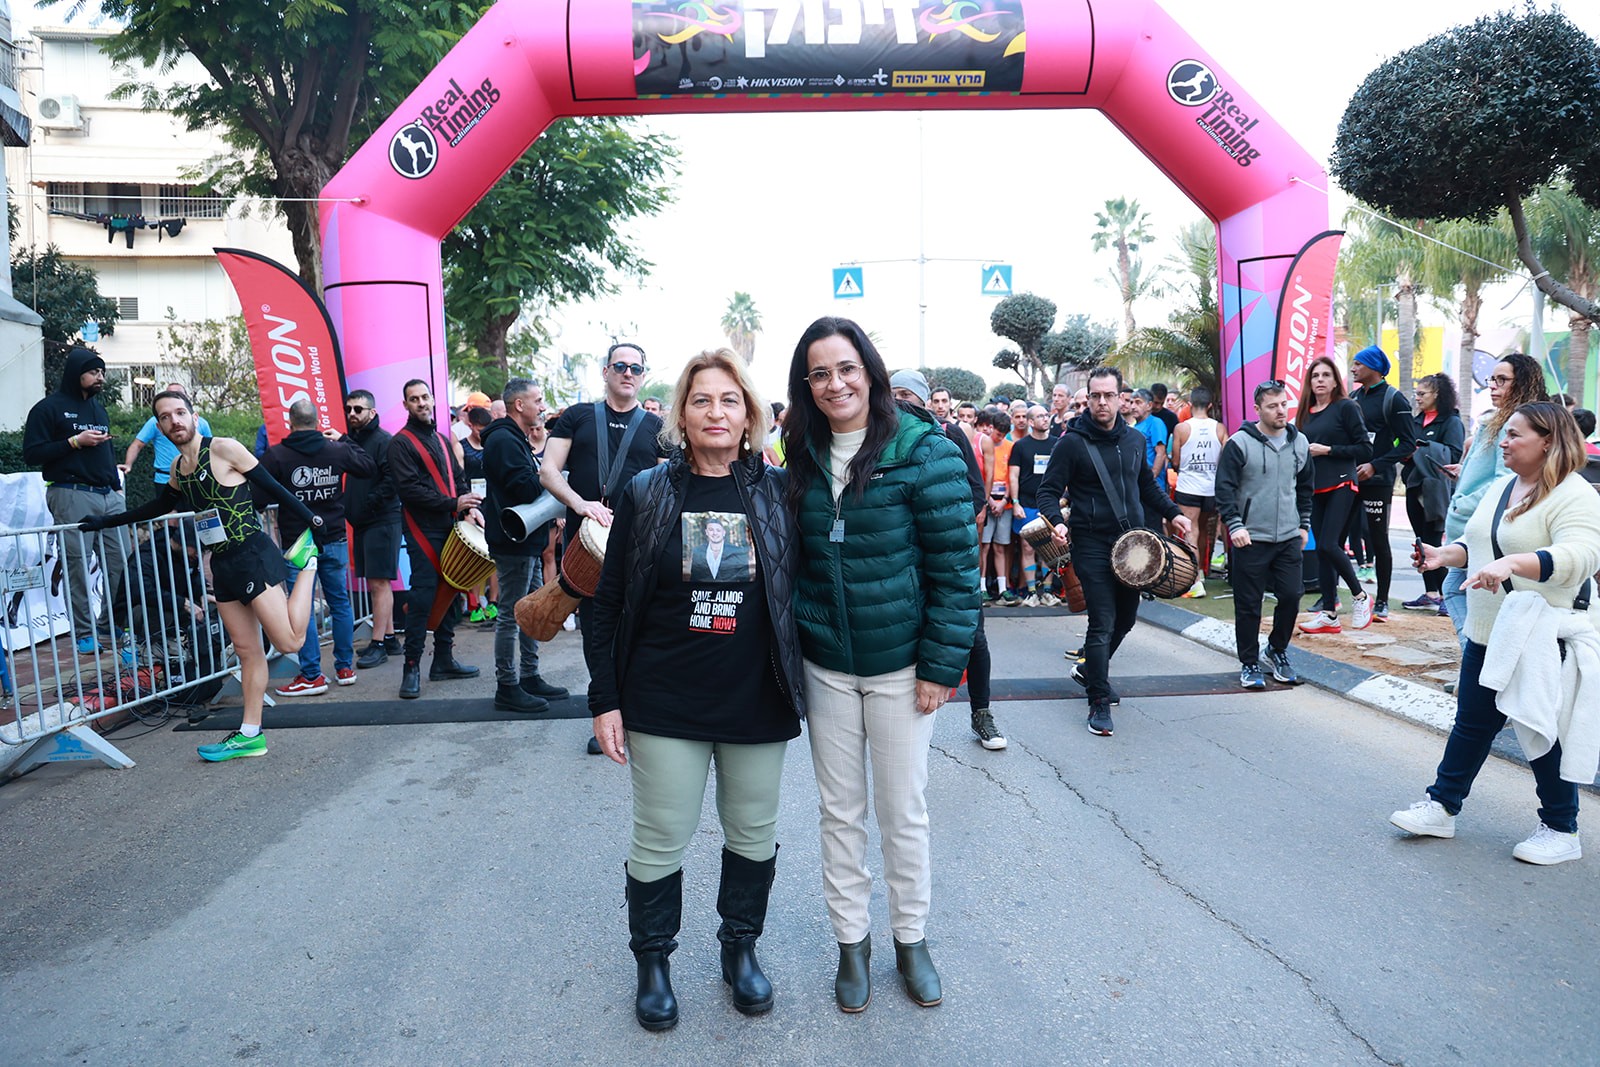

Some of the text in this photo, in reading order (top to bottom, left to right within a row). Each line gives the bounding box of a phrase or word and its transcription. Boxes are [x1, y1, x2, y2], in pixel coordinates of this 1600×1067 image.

[750, 78, 806, 87] HIKVISION
[895, 74, 982, 85] מרוץ אור יהודה
[420, 78, 464, 128] Real
[432, 77, 501, 142] Timing
[1215, 91, 1259, 132] Real
[1201, 101, 1261, 167] Timing
[1309, 318, 1319, 345] World
[307, 346, 321, 375] World
[315, 377, 327, 404] Safer
[321, 414, 331, 429] for
[312, 465, 332, 477] Real
[690, 614, 737, 631] HOME NOW!
[694, 602, 736, 617] AND BRING
